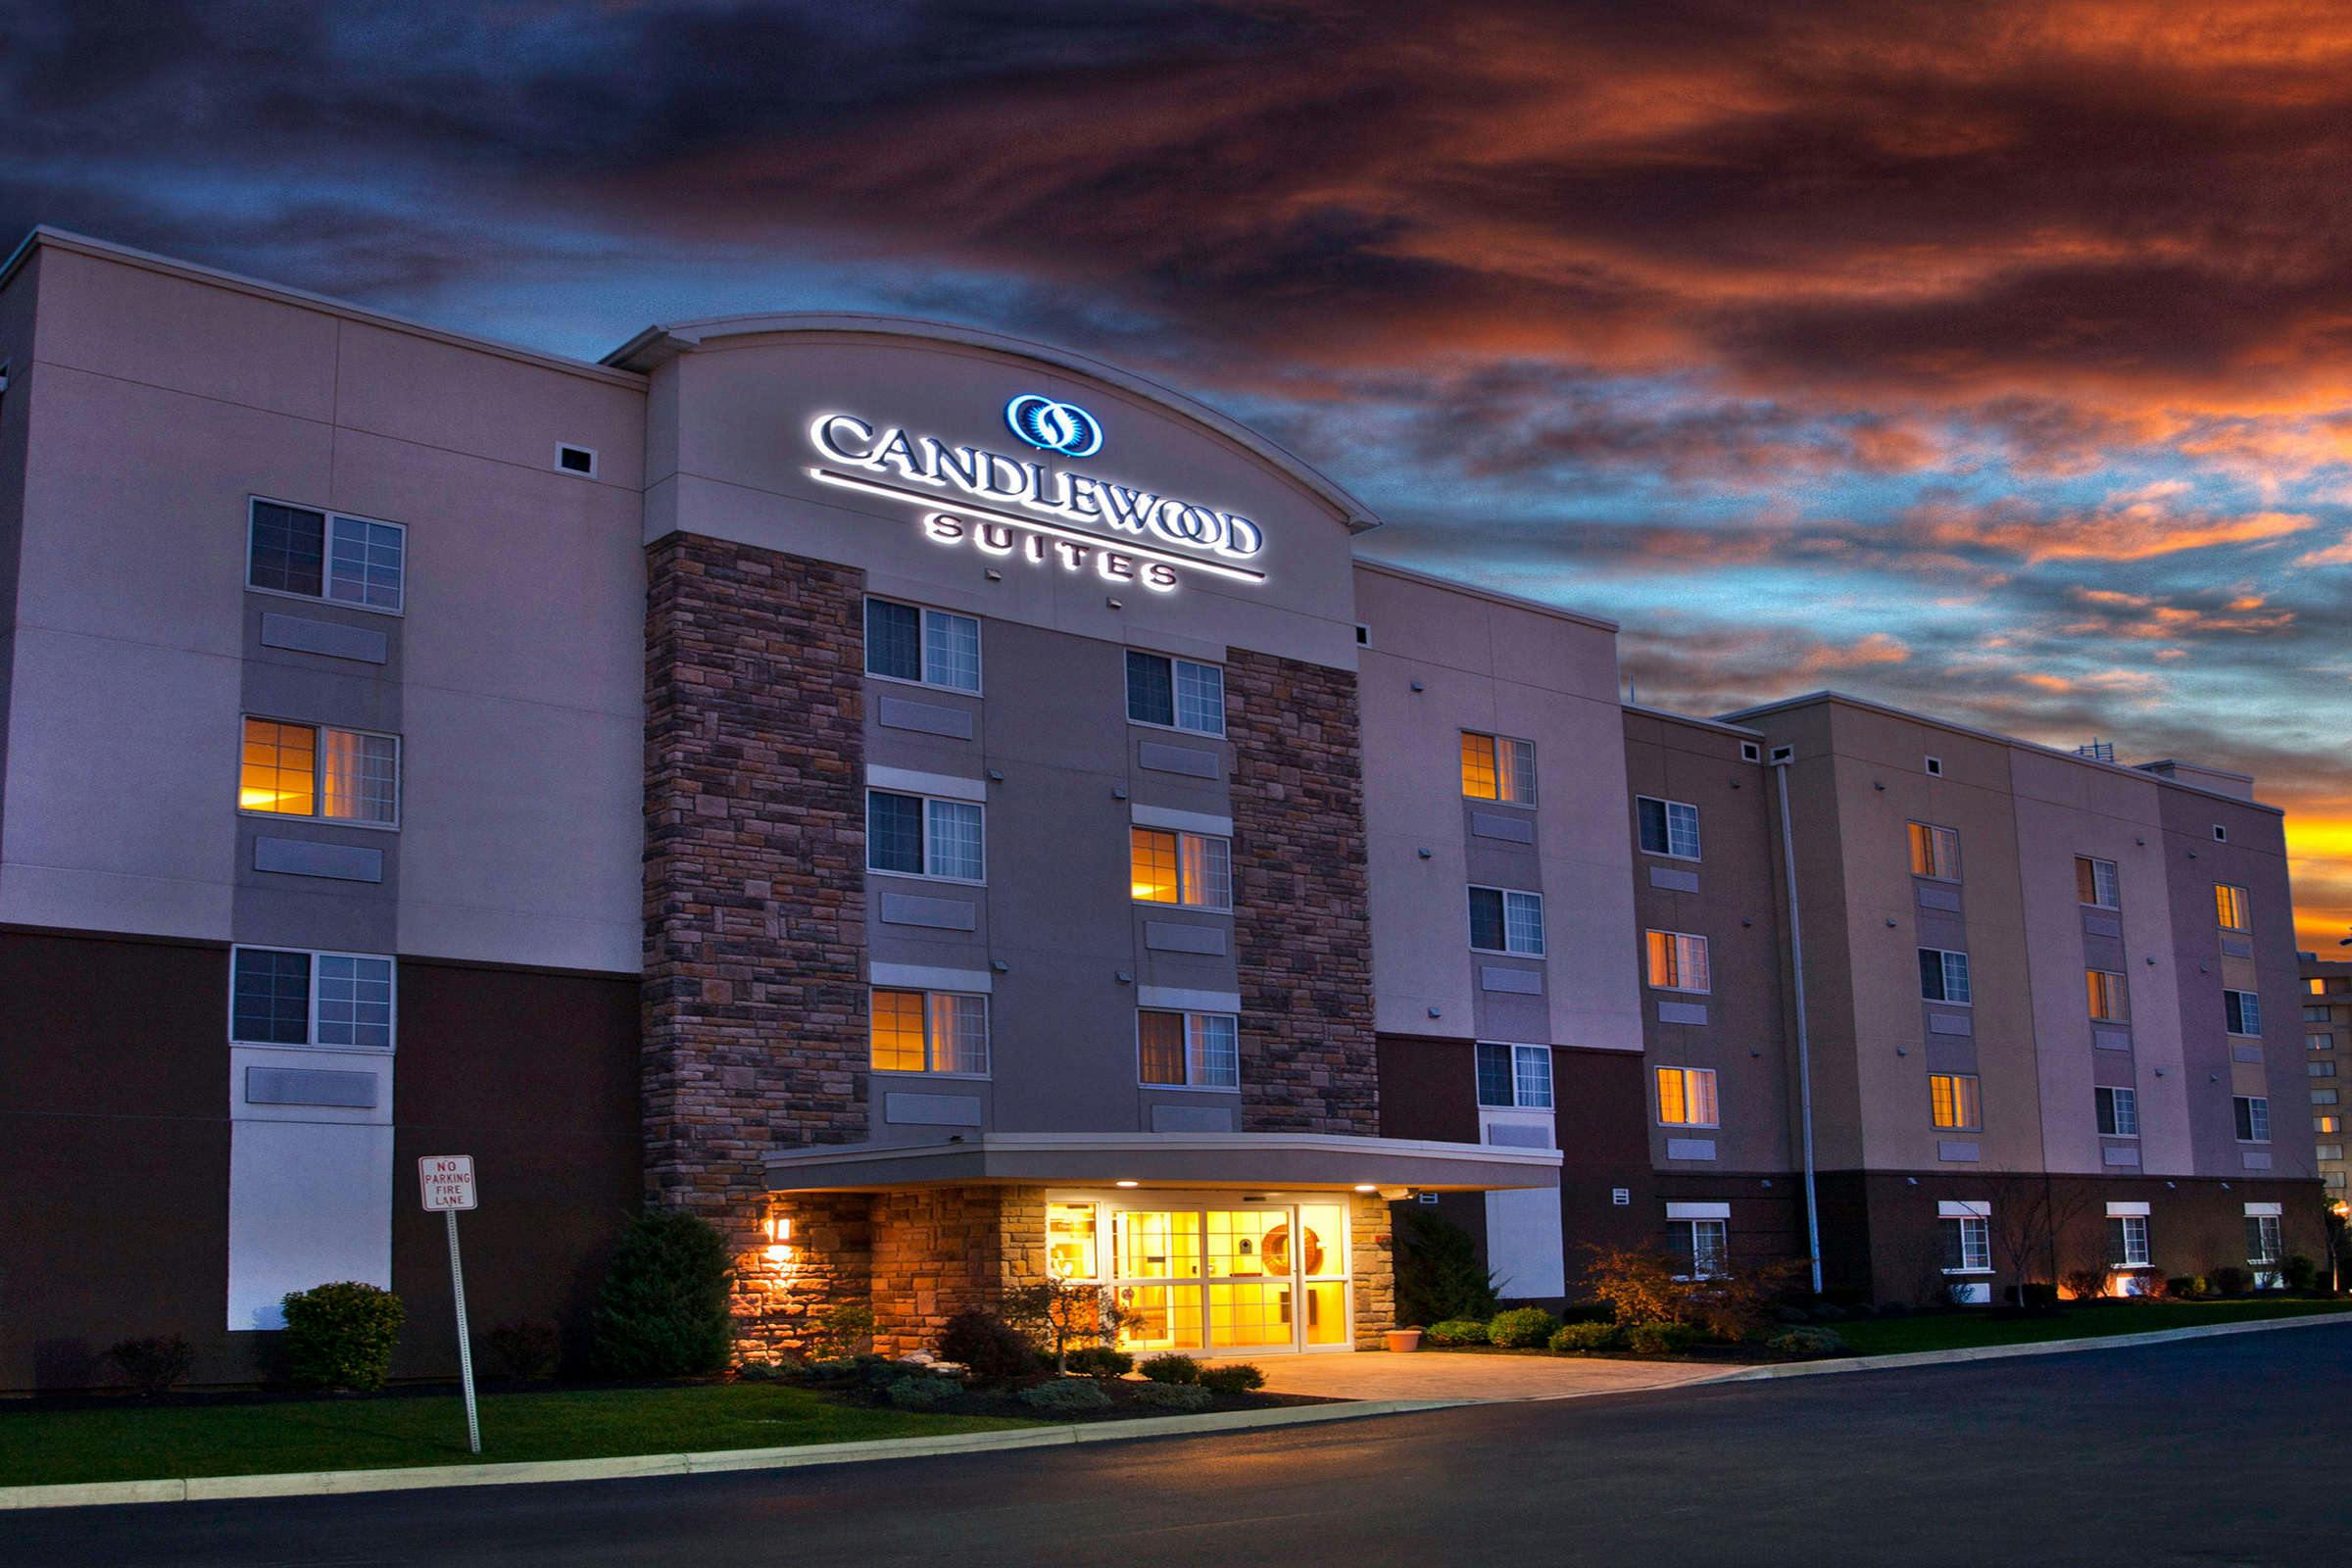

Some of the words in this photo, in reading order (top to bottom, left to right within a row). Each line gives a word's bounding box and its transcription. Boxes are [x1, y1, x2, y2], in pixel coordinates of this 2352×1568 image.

[809, 414, 1263, 558] CANDLEWOOD
[924, 513, 1178, 592] SUITES
[437, 1161, 457, 1172] NO
[425, 1173, 470, 1184] PARKING
[436, 1185, 462, 1195] FIRE
[435, 1196, 464, 1205] LANE
